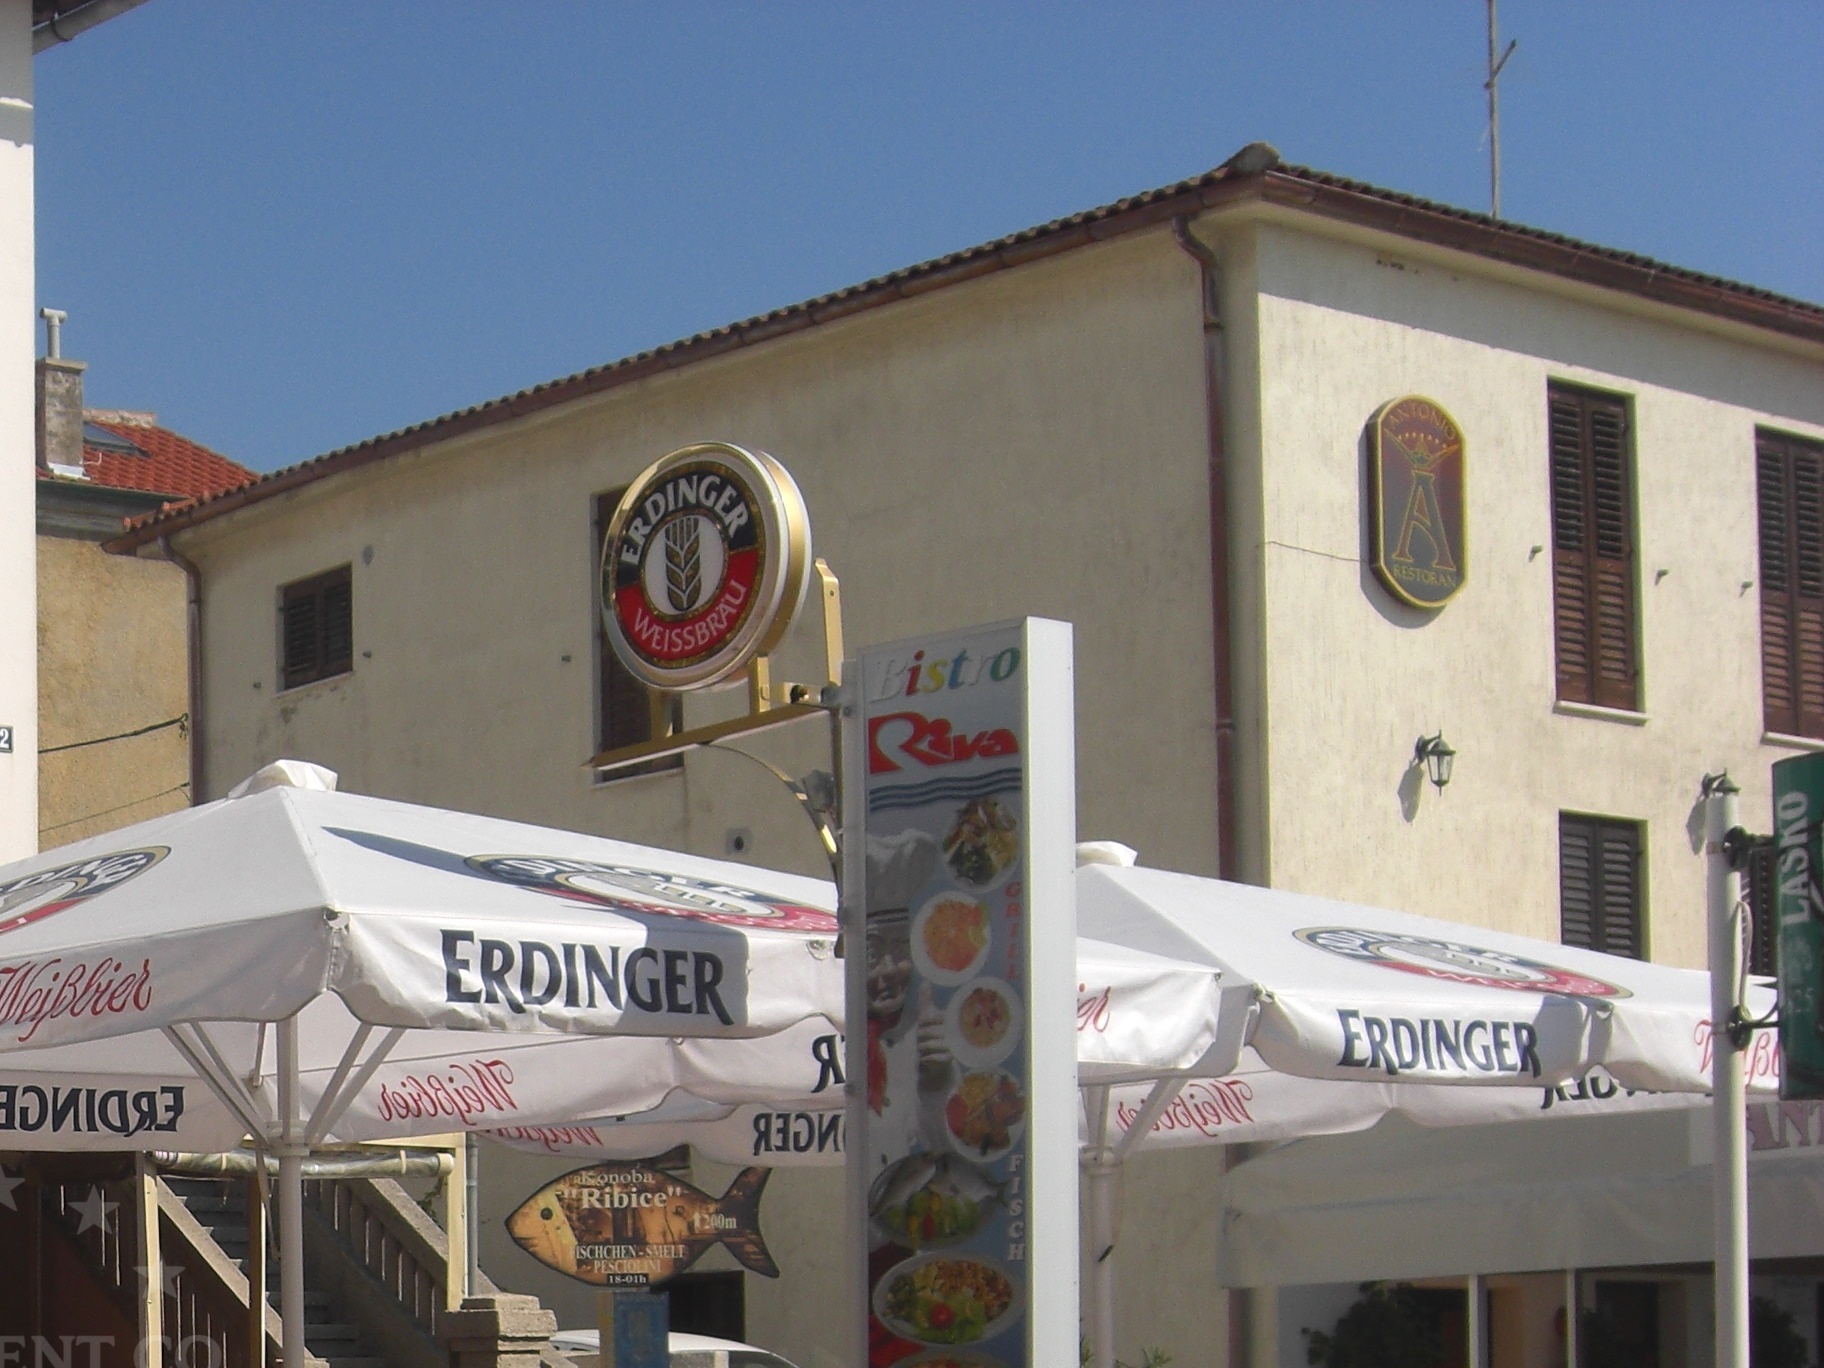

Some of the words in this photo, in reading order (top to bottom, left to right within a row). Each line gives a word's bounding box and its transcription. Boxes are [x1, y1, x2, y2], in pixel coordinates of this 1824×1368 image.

[1388, 402, 1456, 440] ANTONIO
[620, 474, 750, 566] ERDINGER
[1393, 563, 1456, 587] RESTORAN
[634, 579, 748, 653] WEISSBRÄU
[868, 711, 1020, 775] Riva
[441, 929, 735, 1026] ERDINGER
[1336, 1009, 1541, 1078] ERDINGER
